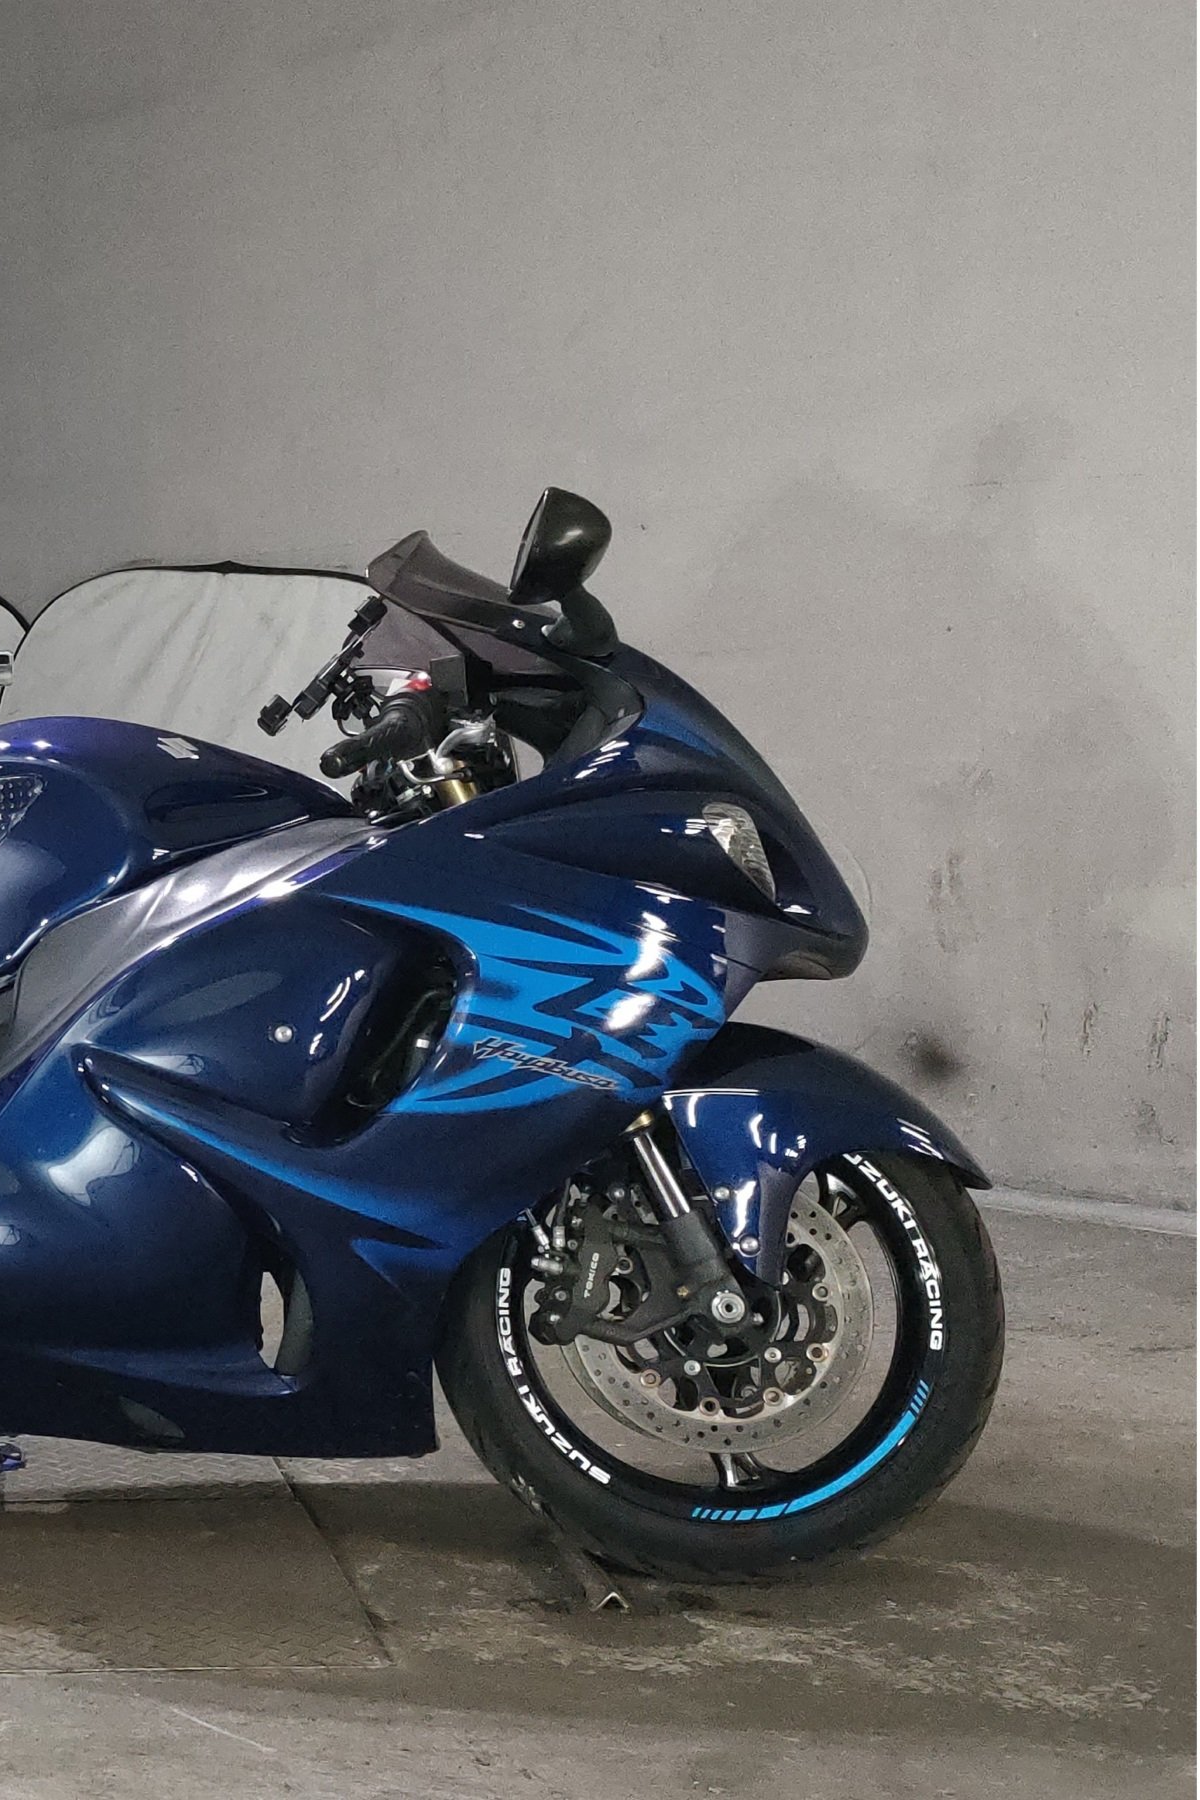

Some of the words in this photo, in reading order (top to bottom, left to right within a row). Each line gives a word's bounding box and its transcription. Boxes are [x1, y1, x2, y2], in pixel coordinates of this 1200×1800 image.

[473, 1036, 619, 1089] Hayabusa
[499, 1267, 523, 1377] RACING
[583, 1252, 600, 1298] TOKICO
[912, 1237, 943, 1350] RACING
[518, 1385, 611, 1485] SUZUKI
